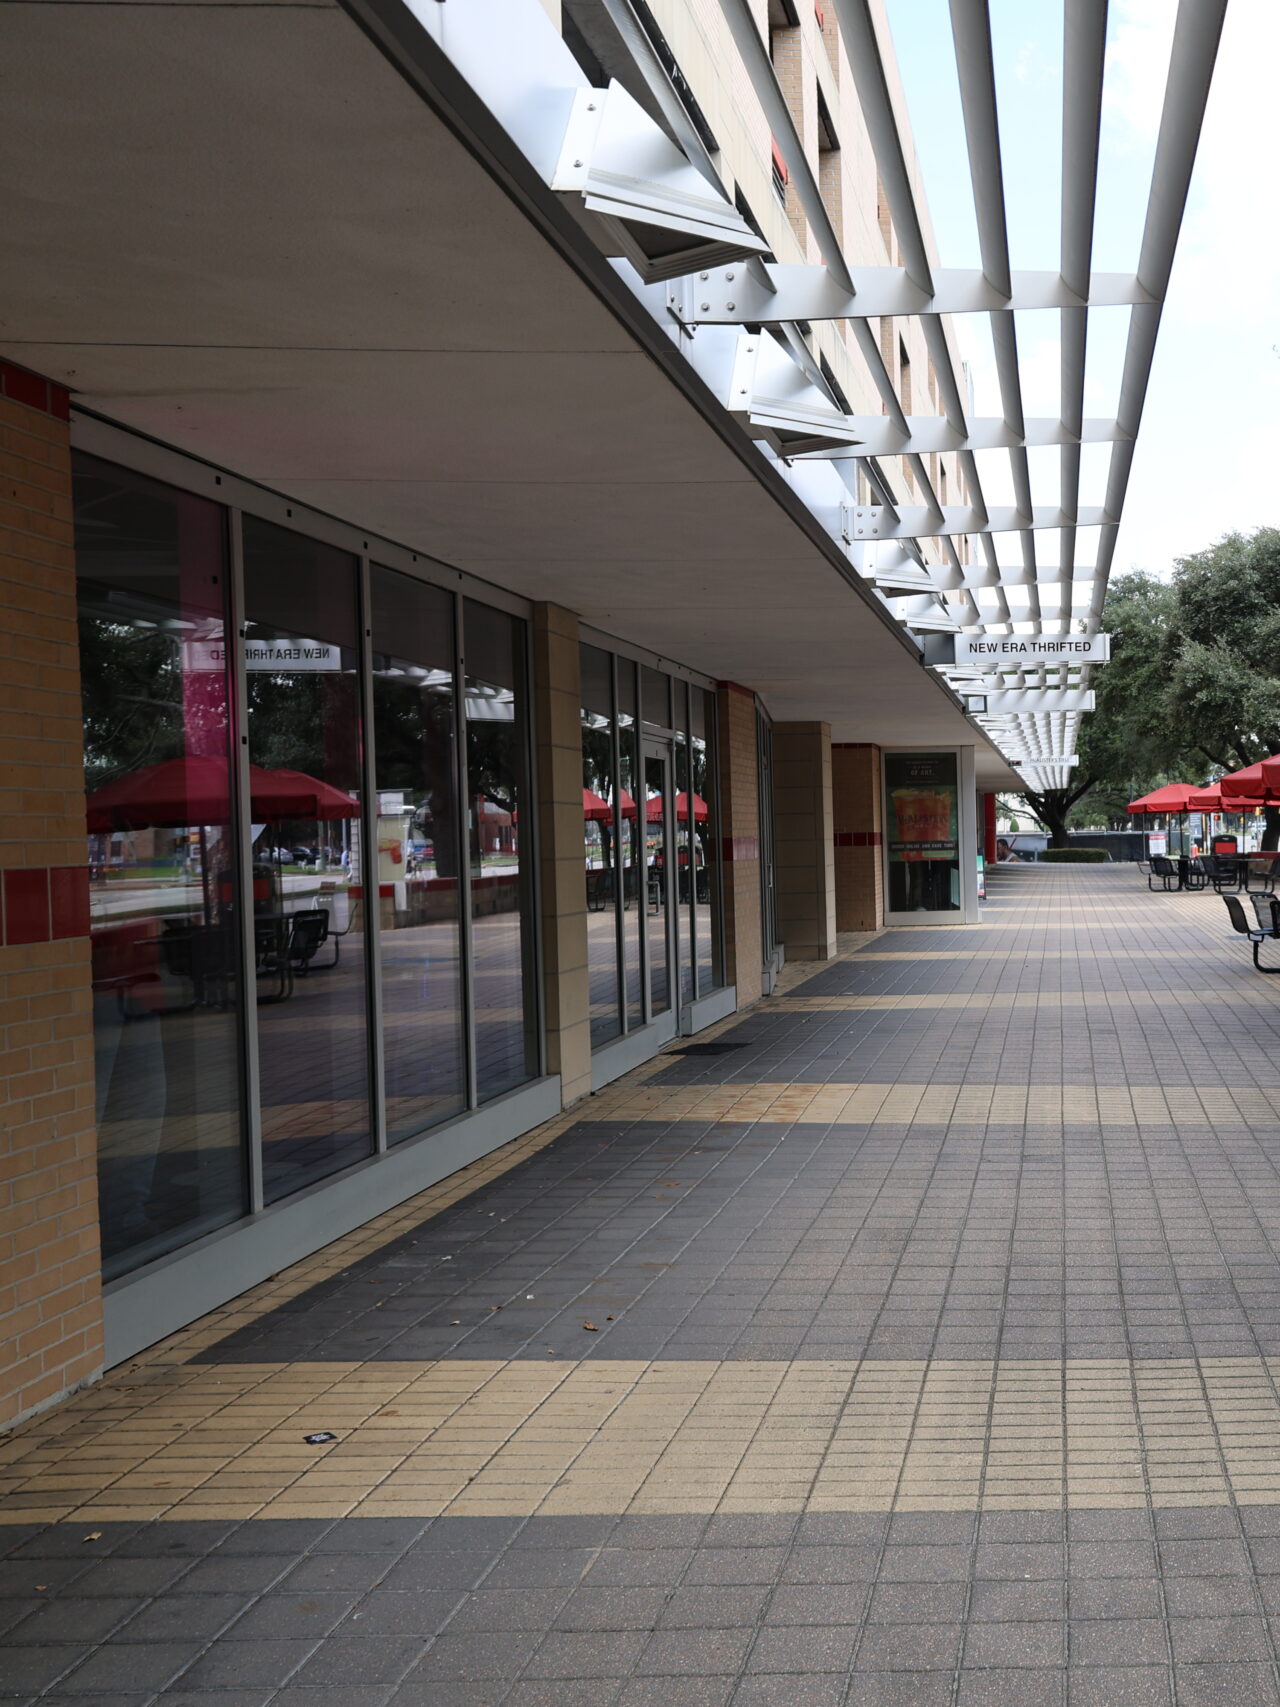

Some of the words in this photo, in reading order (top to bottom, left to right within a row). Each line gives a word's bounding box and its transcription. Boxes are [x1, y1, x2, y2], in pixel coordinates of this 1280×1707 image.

[969, 643, 998, 653] NEW
[1002, 642, 1027, 653] ERA
[1031, 641, 1092, 653] THRIFTED
